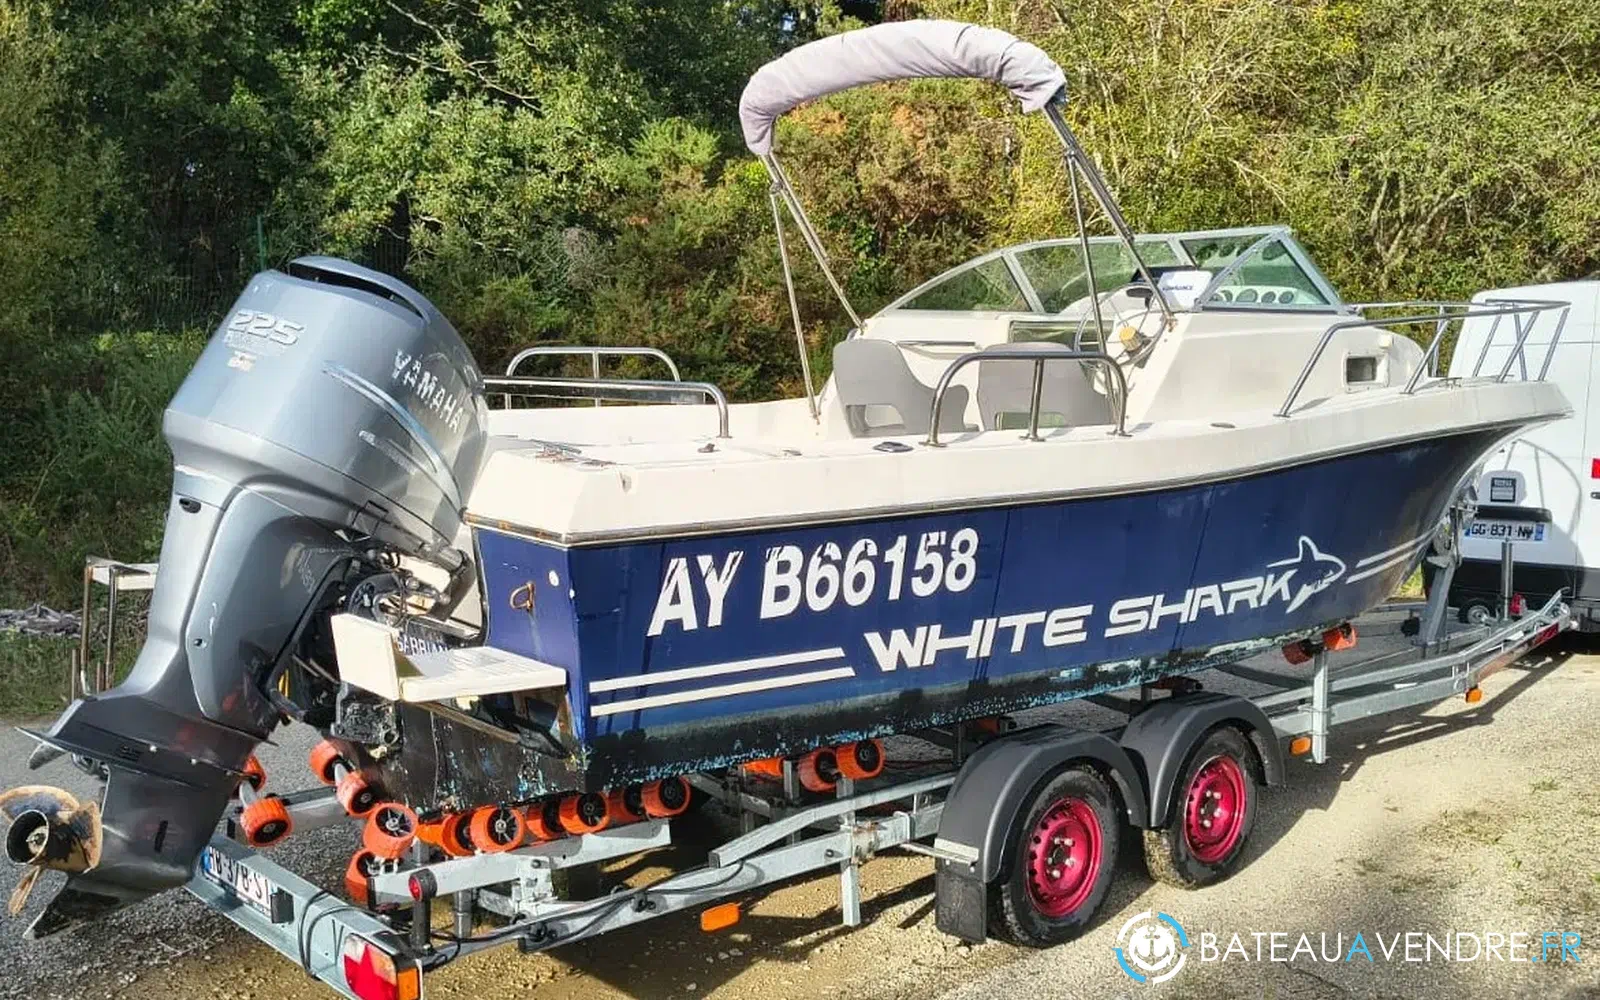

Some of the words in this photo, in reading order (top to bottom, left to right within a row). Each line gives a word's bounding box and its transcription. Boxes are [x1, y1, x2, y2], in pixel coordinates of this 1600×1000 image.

[228, 309, 305, 346] 225
[392, 348, 463, 433] YAMAHA
[647, 550, 744, 637] AY
[760, 527, 979, 619] B66158
[864, 604, 1093, 672] WHITE
[1104, 568, 1298, 639] SHARK
